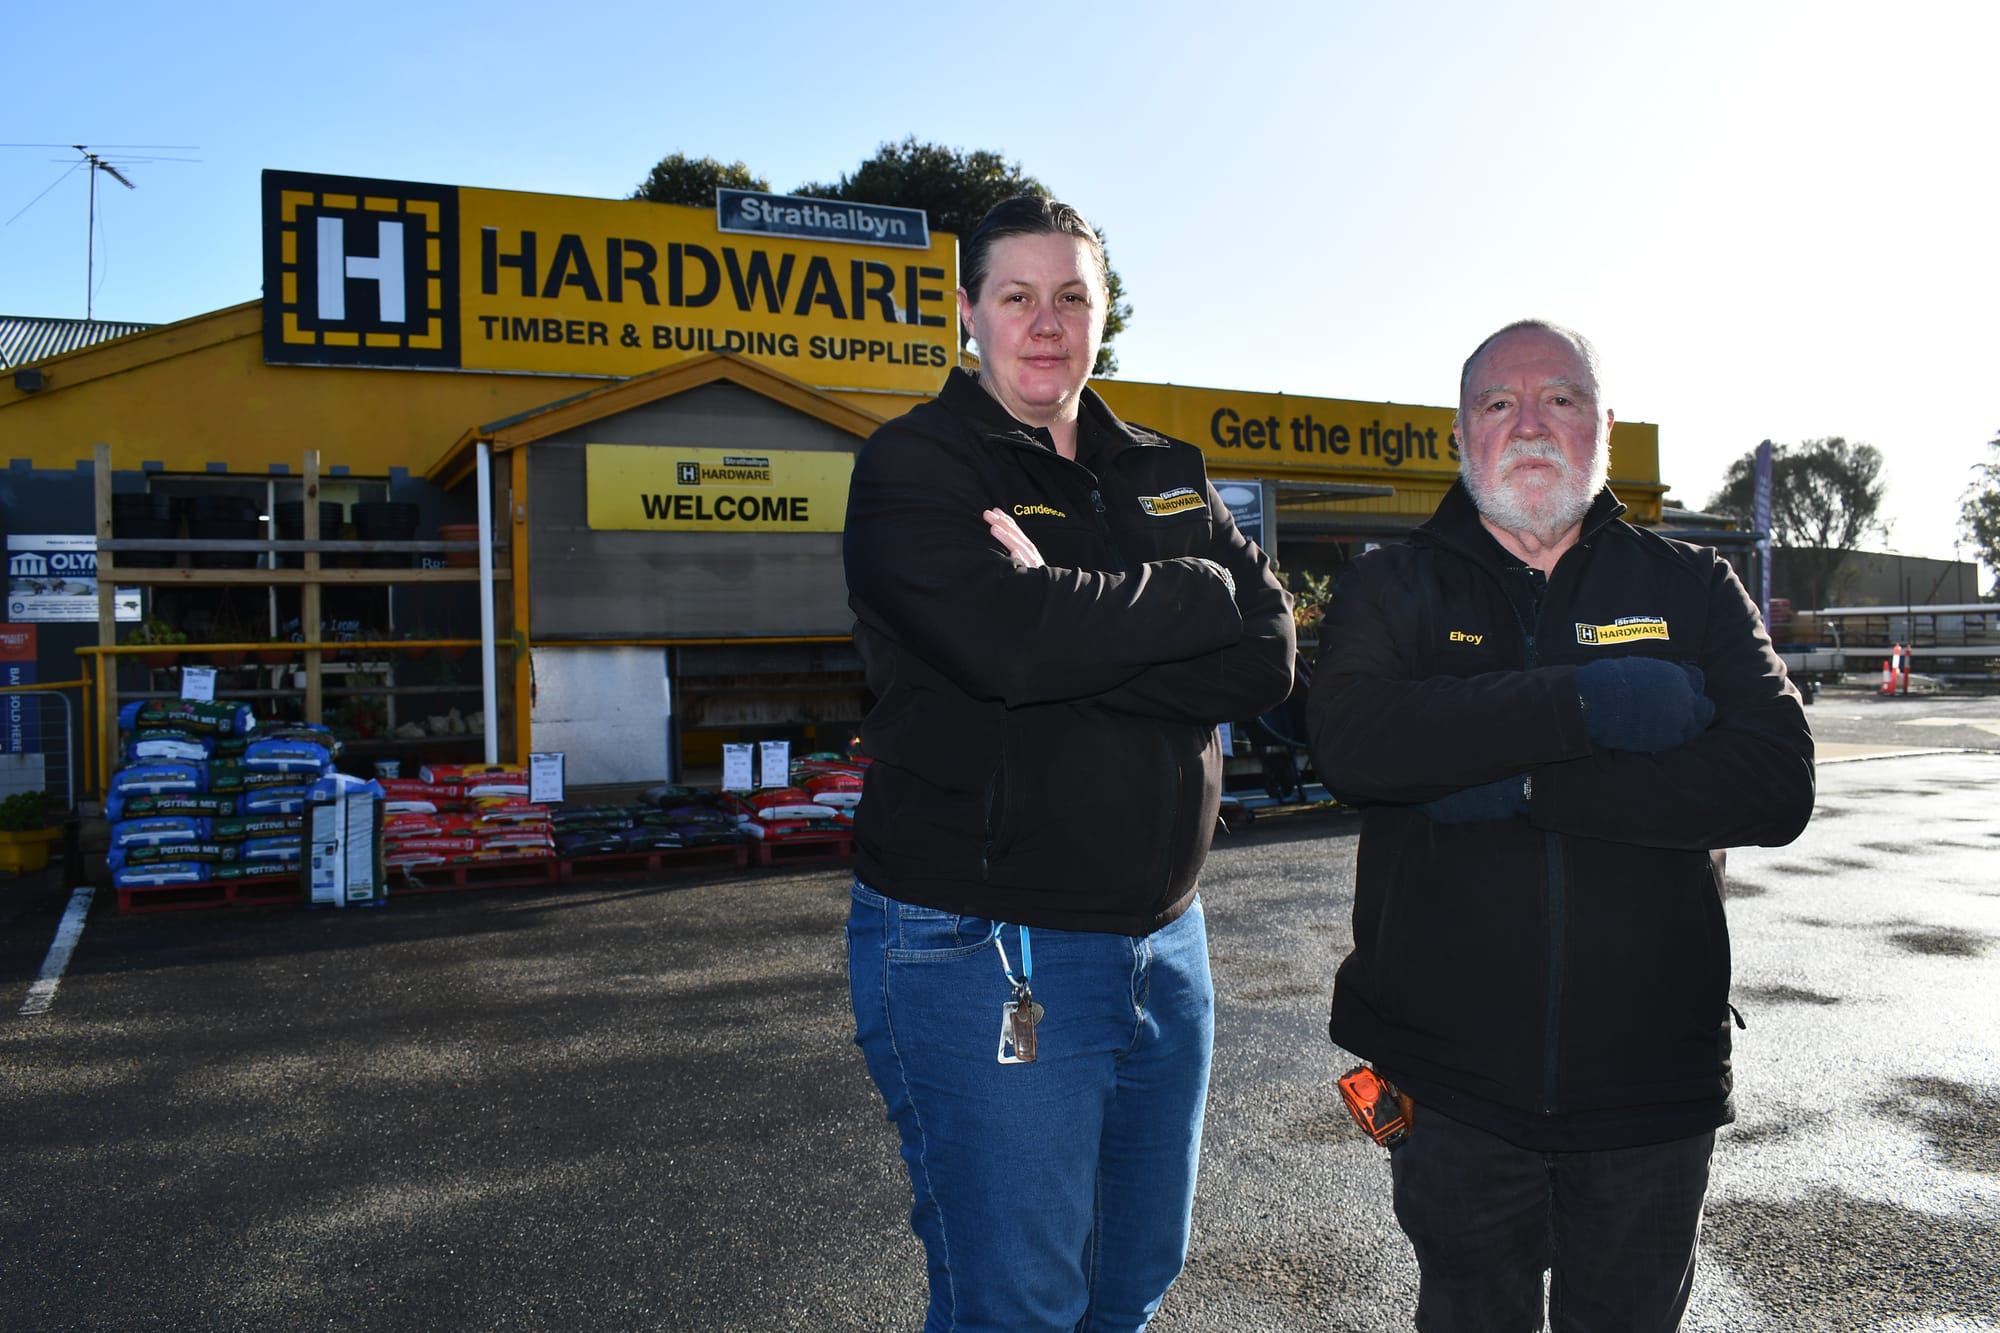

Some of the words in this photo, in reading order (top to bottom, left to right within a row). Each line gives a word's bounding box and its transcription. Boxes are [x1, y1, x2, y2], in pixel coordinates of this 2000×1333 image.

[741, 198, 907, 238] Strathalbyn
[481, 227, 947, 327] HARDWARE
[479, 315, 609, 347] TIMBER
[620, 323, 640, 349] &
[653, 325, 799, 357] BUILDING
[809, 336, 947, 368] SUPPLIES
[1211, 407, 1281, 450] Get
[1291, 415, 1350, 455] the
[1360, 420, 1438, 466] right
[702, 469, 770, 481] HARDWARE
[641, 493, 809, 522] WELCOME
[1156, 496, 1201, 511] HARDWARE
[1449, 631, 1484, 646] Elroy
[1600, 626, 1665, 639] HARDWARE
[9, 667, 20, 686] BAI
[11, 723, 22, 752] HERE
[157, 799, 197, 809] POTTING
[200, 800, 218, 808] MIX
[245, 821, 286, 832] POTTING
[160, 845, 200, 855] POTTING
[202, 845, 220, 854] MIX
[245, 864, 285, 876] POTTING
